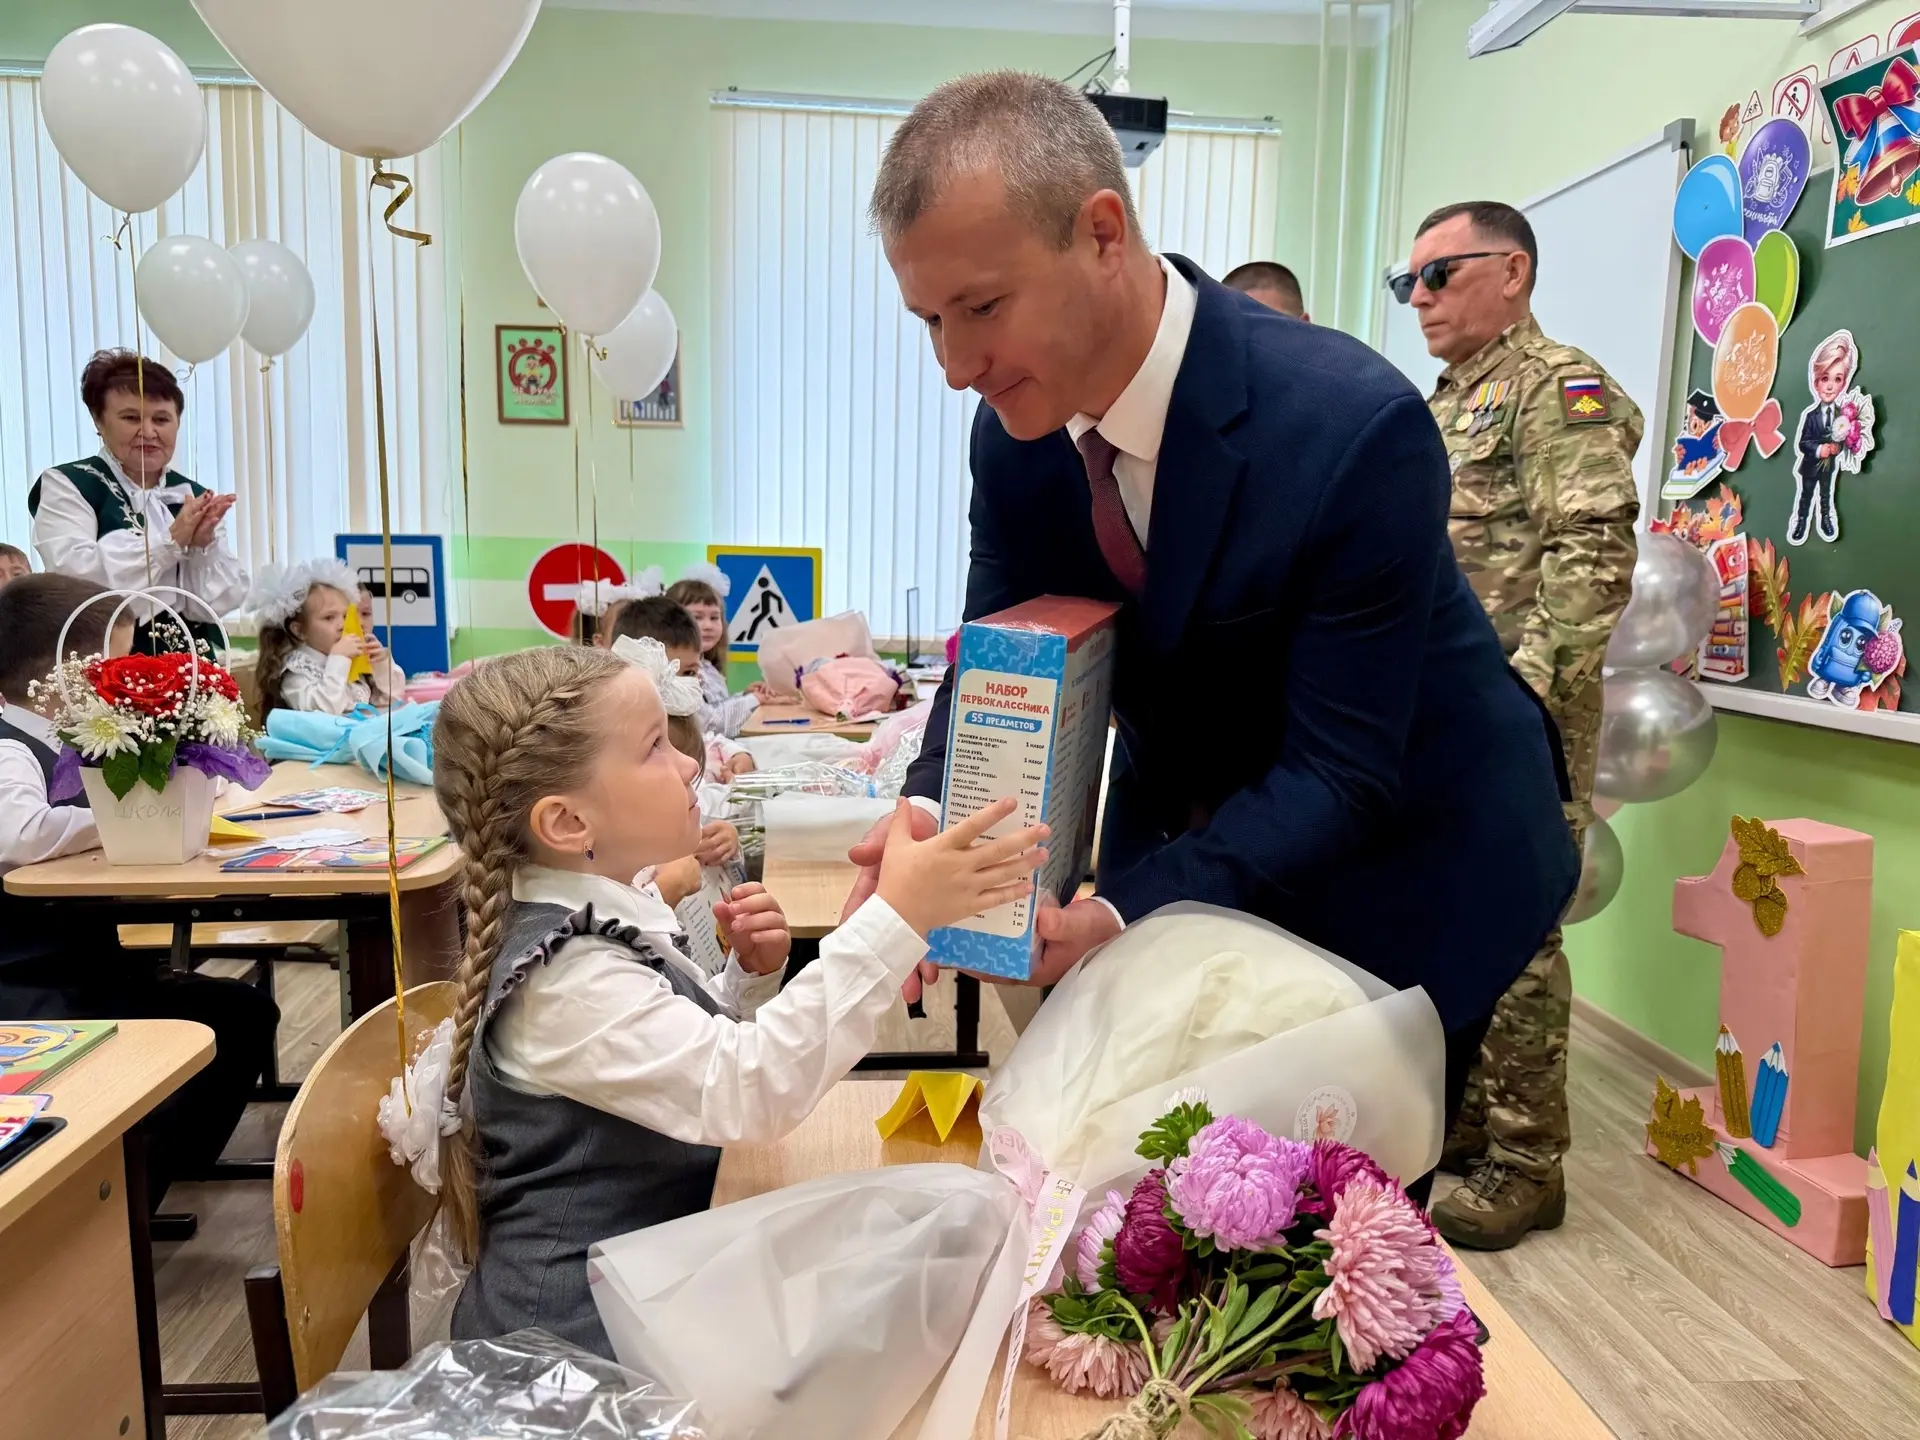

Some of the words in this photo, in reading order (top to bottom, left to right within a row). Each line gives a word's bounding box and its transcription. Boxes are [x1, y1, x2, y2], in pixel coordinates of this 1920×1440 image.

[985, 681, 1028, 699] НАБОР
[960, 694, 1050, 715] ПЕРВОКЛАССНИКА
[971, 712, 984, 723] 55
[985, 716, 1035, 731] ПРЕДМЕТОВ
[114, 804, 182, 821] ШКОЛА
